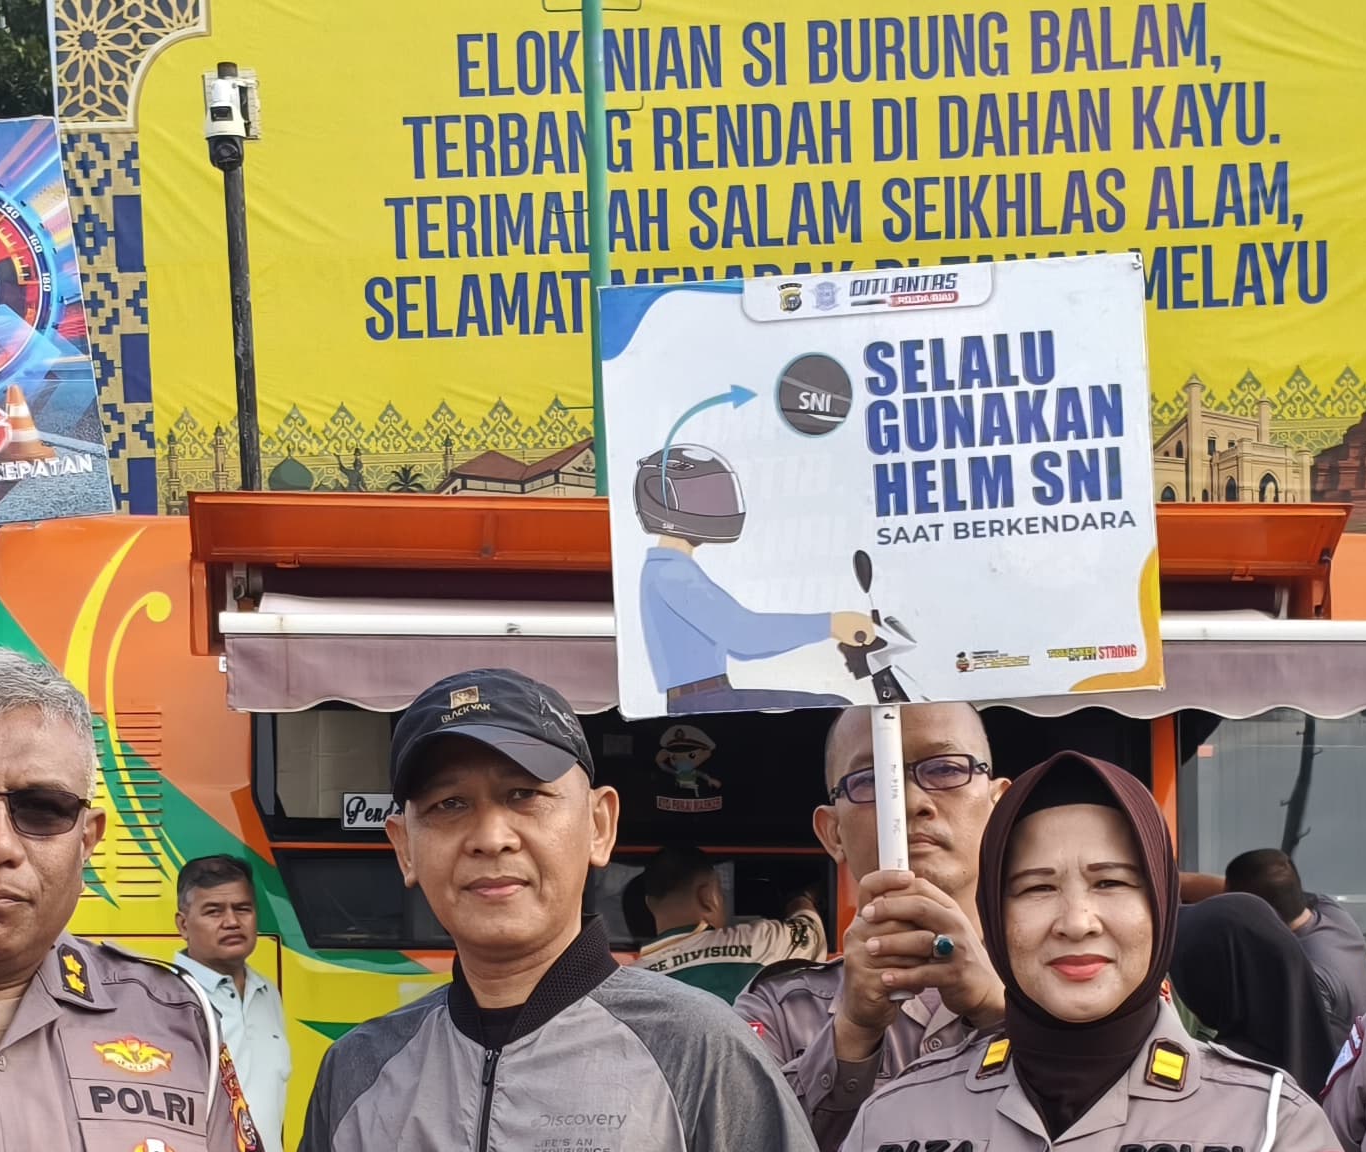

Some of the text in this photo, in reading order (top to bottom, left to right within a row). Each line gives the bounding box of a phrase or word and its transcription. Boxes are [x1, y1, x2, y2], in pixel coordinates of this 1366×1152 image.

[457, 2, 1221, 98] ELOK NIAN SI BURUNG BALAM,
[402, 81, 1280, 180] TERBANG RENDAH DI DAHAN KAYU.
[1, 202, 20, 220] 140
[384, 161, 1305, 260] TERIMALAH SALAM SEIKHLAS ALAM,
[28, 235, 43, 254] 160
[41, 272, 52, 292] 180
[850, 273, 958, 296] DITLANTAS
[1129, 240, 1328, 310] MELAYU
[364, 270, 591, 341] SELAMAT
[863, 330, 1056, 397] SELALU
[798, 390, 831, 413] SNI
[864, 383, 1124, 456] GUNAKAN
[873, 446, 1124, 518] HELM SNI
[876, 509, 1136, 546] SAAT BERKENDARA
[672, 945, 752, 968] DIVISION
[91, 1085, 195, 1126] POLRI
[538, 1113, 627, 1130] Discovery
[575, 1138, 593, 1147] AN
